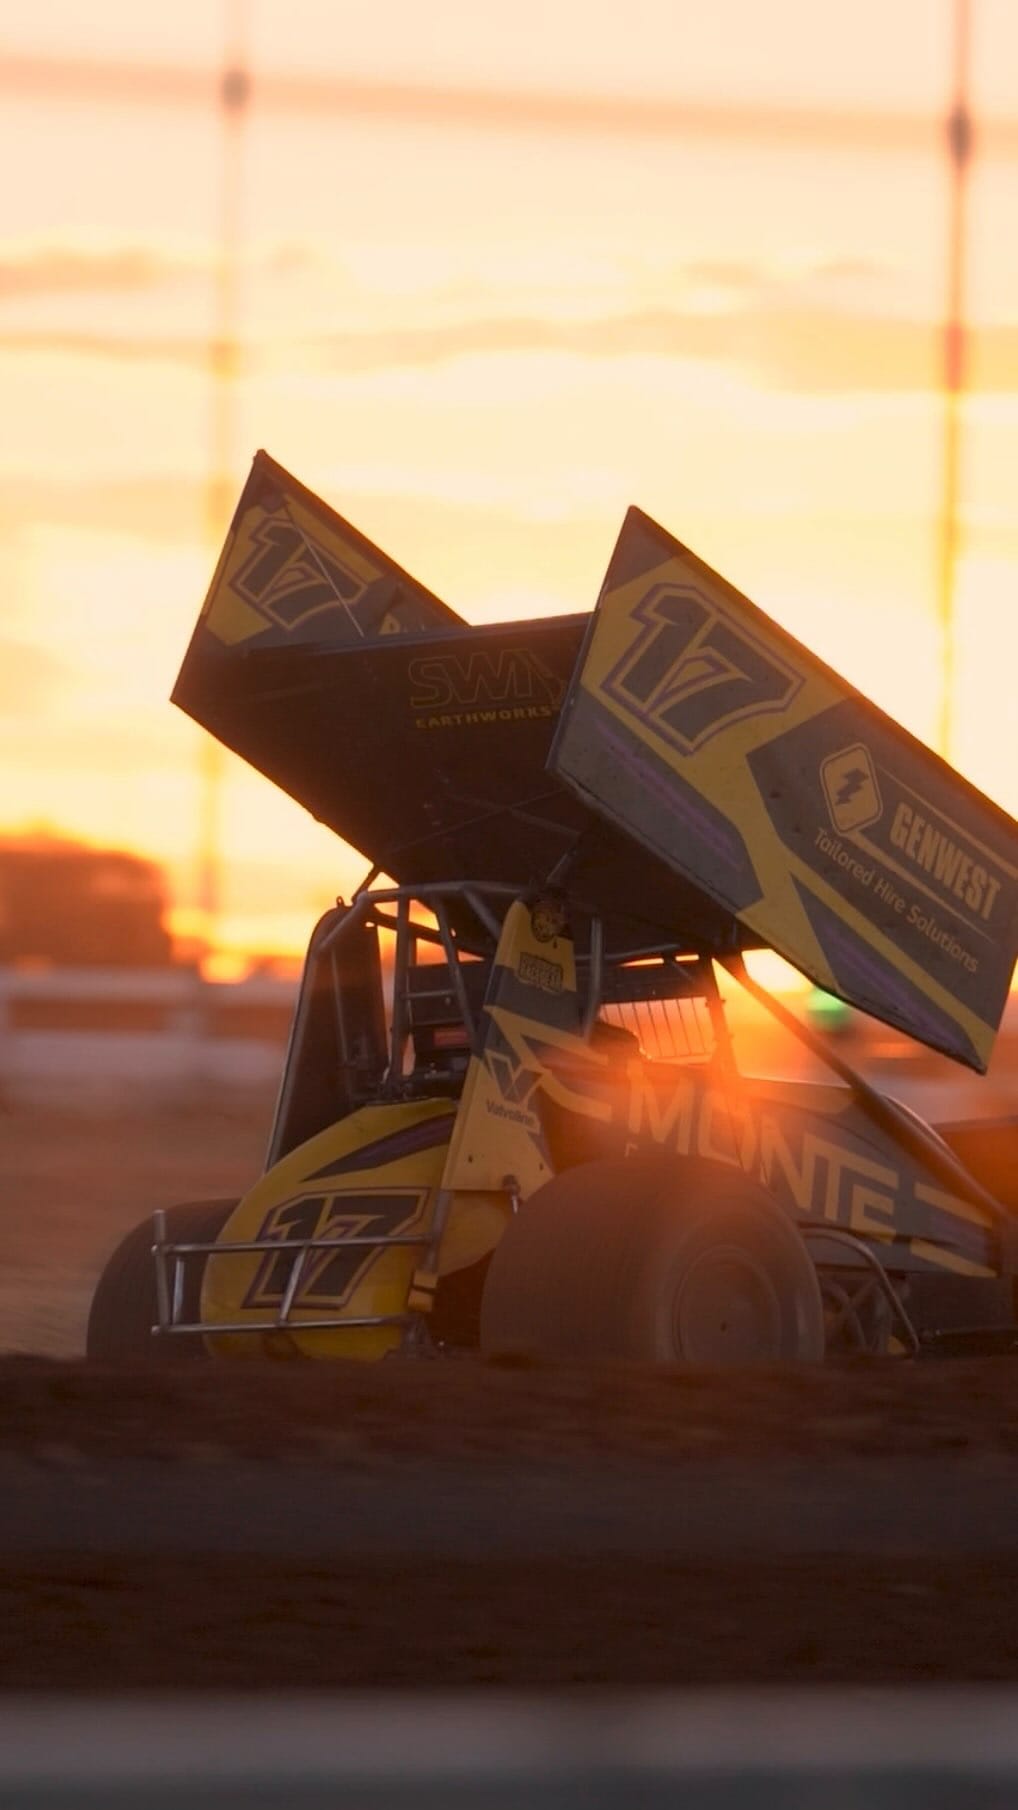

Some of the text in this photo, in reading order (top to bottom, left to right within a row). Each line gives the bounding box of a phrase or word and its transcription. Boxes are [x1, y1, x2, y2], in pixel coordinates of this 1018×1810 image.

[229, 514, 369, 630] 17
[415, 706, 552, 729] EARTHWORKS
[601, 582, 807, 757] 17
[814, 828, 979, 973] Tailored Hire Solutions
[889, 802, 1001, 920] GENWEST
[240, 1187, 431, 1310] 17
